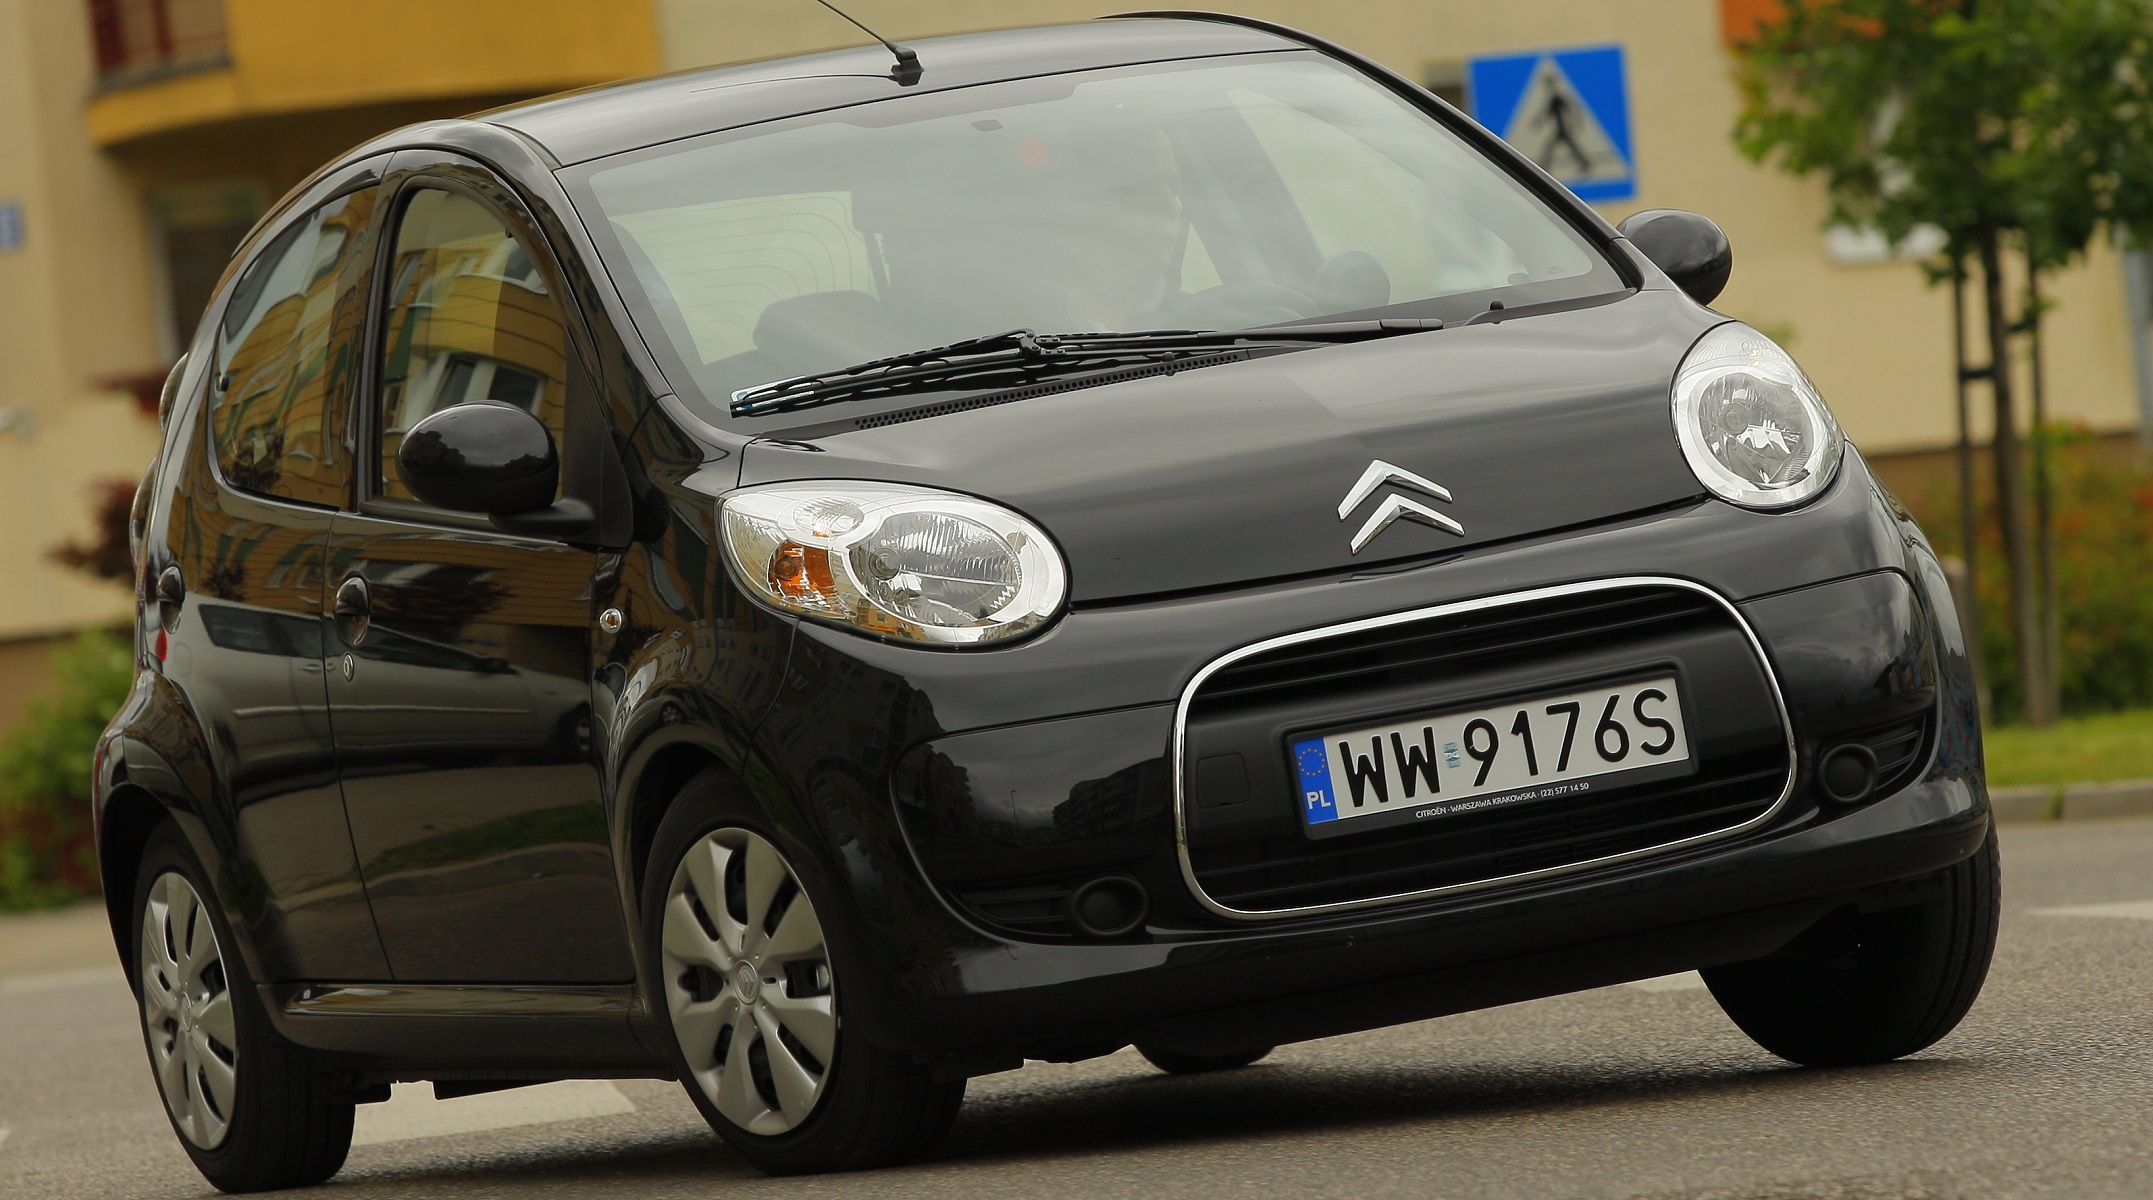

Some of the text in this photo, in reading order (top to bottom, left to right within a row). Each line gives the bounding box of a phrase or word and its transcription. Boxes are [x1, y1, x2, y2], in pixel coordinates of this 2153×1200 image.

[1338, 688, 1676, 808] WW 9176S
[1306, 790, 1331, 810] PL
[1450, 799, 1492, 813] WARSZAWA
[1492, 791, 1537, 805] KRAKOWSKA
[1540, 788, 1554, 798] (22)
[1555, 785, 1568, 795] 577
[1570, 783, 1579, 792] 14
[1580, 782, 1590, 791] 50
